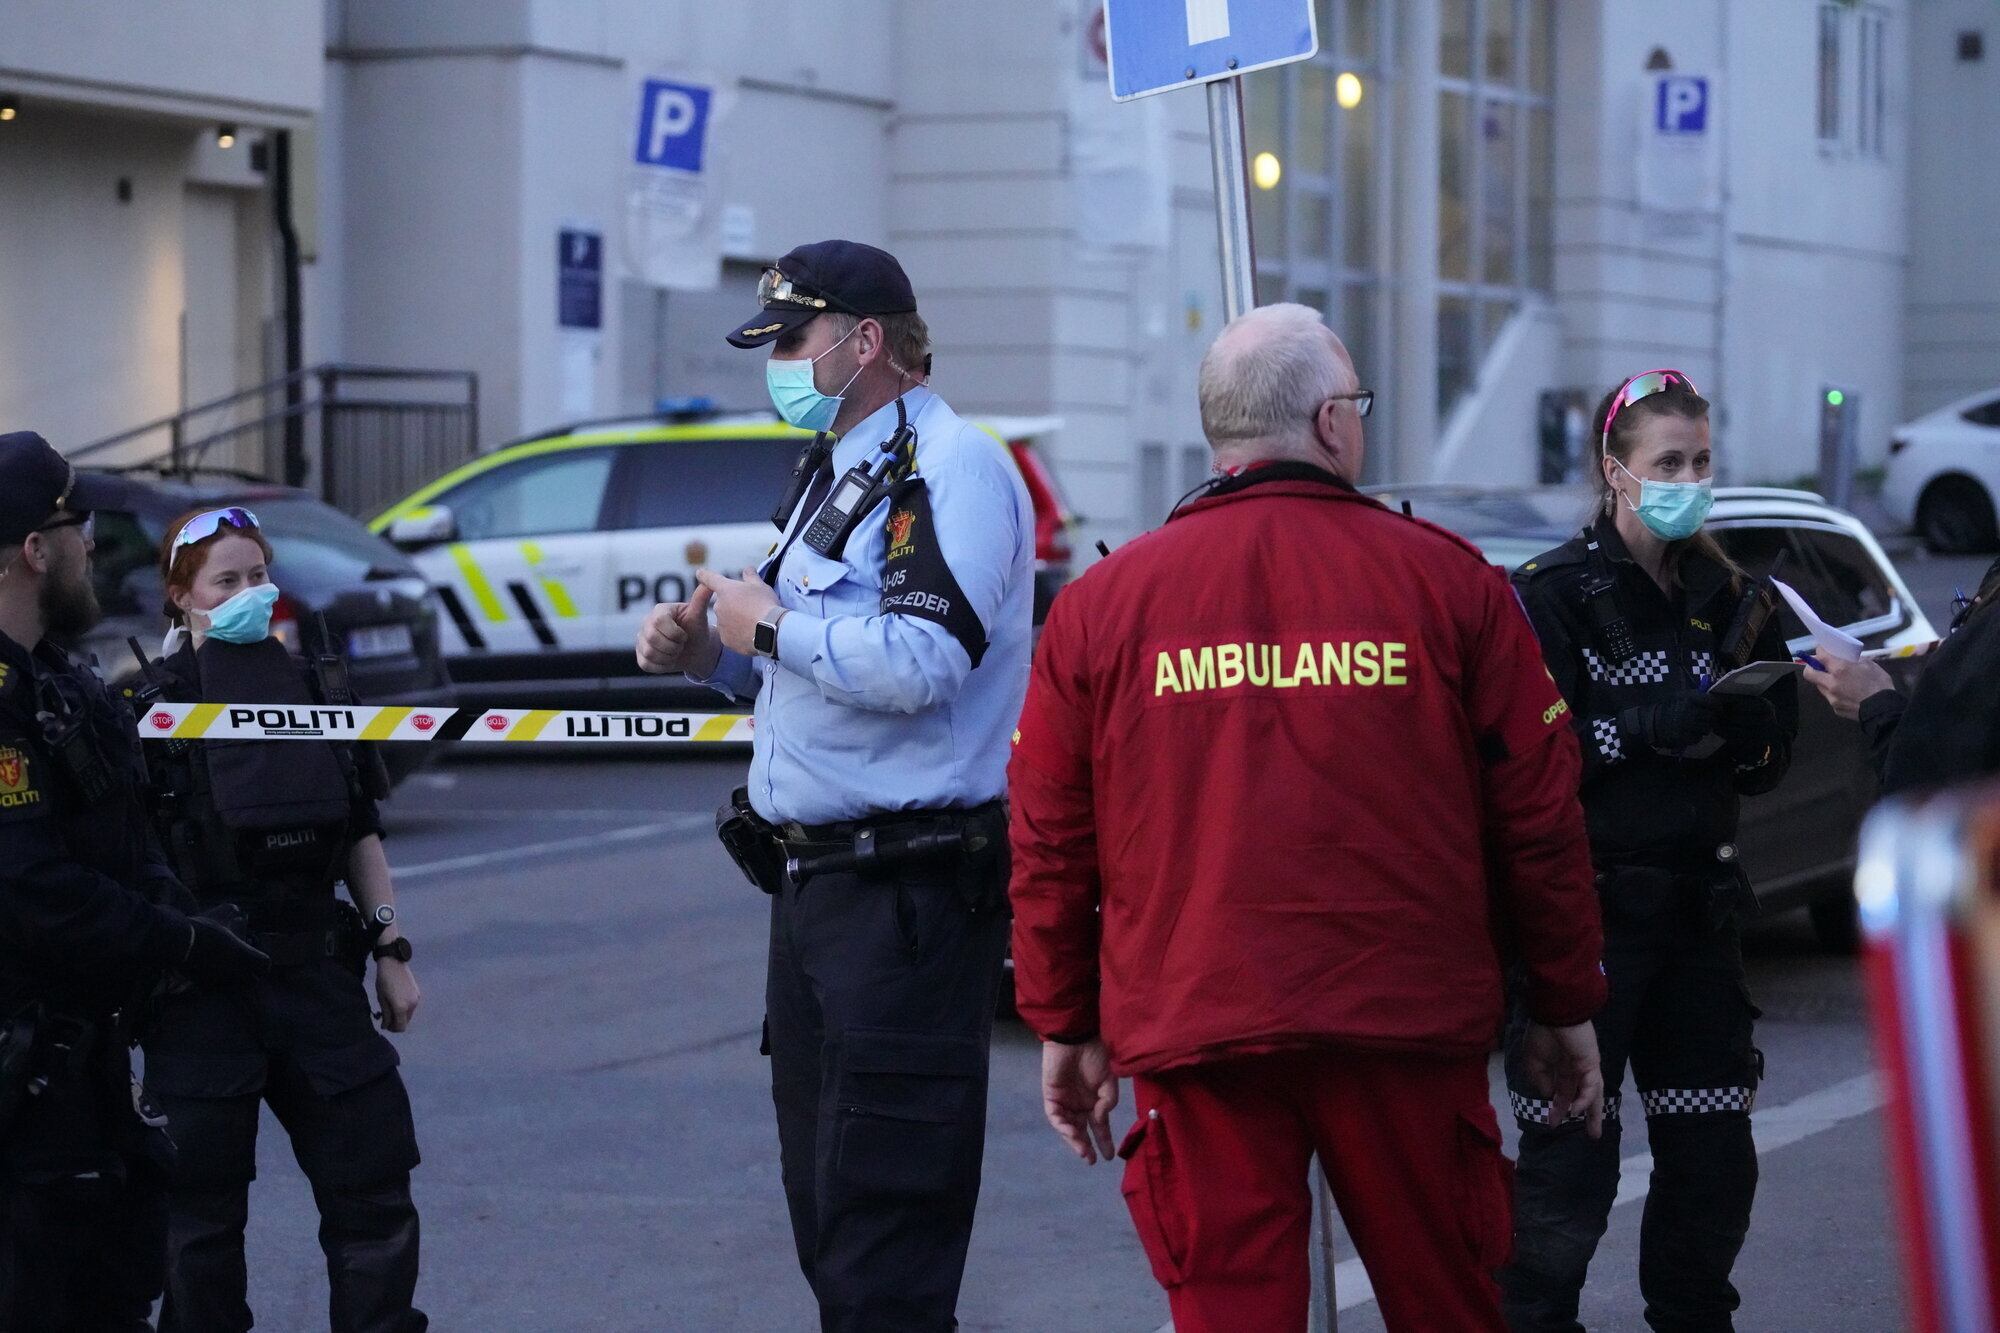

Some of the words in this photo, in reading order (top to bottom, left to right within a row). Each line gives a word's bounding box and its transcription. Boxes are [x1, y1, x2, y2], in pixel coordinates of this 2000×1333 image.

[1666, 81, 1702, 130] P
[648, 87, 697, 160] P
[1155, 641, 1407, 696] AMBULANSE
[152, 716, 173, 725] STOP
[229, 709, 354, 728] POLITI
[413, 717, 433, 725] STOP
[486, 717, 507, 726] STOP
[566, 717, 690, 737] POLITI
[0, 790, 40, 807] OLITI
[266, 829, 316, 848] POLITI
